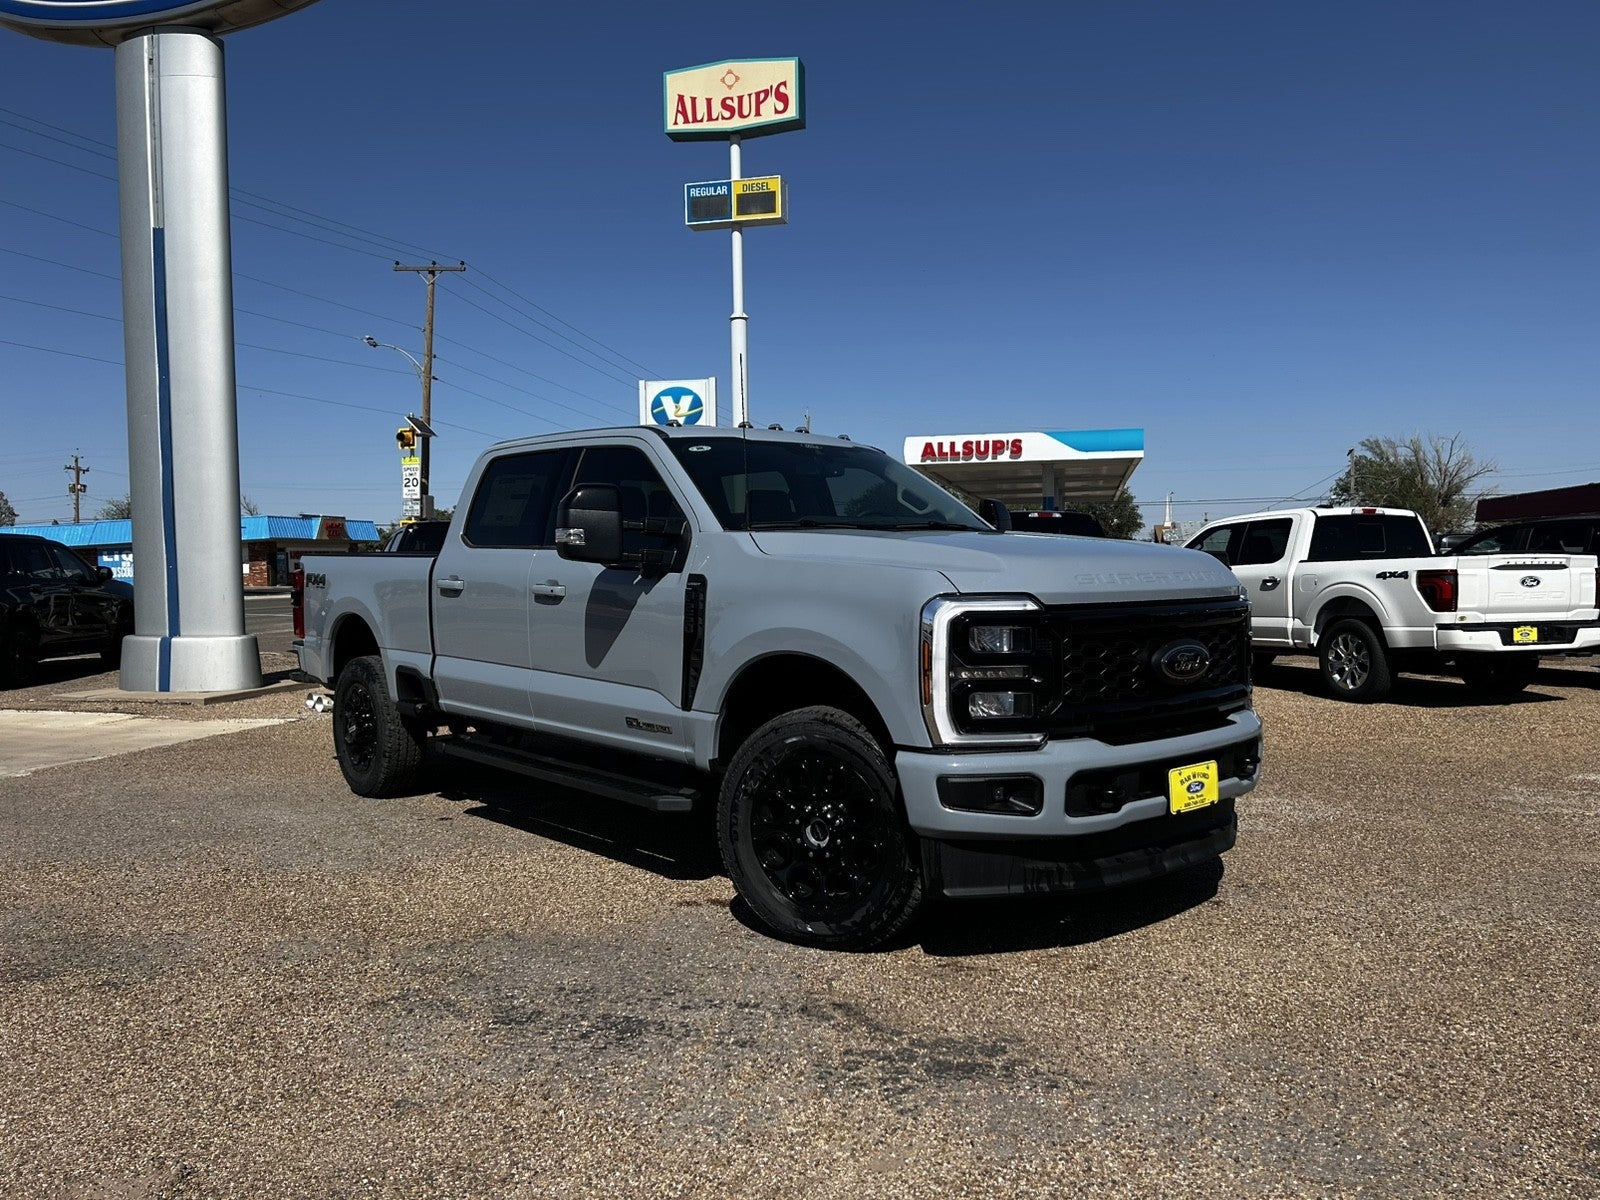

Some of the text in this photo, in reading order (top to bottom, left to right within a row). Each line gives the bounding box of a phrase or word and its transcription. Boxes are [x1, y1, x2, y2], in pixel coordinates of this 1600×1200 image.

[673, 80, 790, 126] ALLSUP'S
[690, 185, 728, 197] REGULAR
[742, 181, 771, 193] DIESEL
[921, 438, 1023, 462] ALLSUP'S
[404, 477, 419, 488] 20
[102, 550, 134, 563] LIQ
